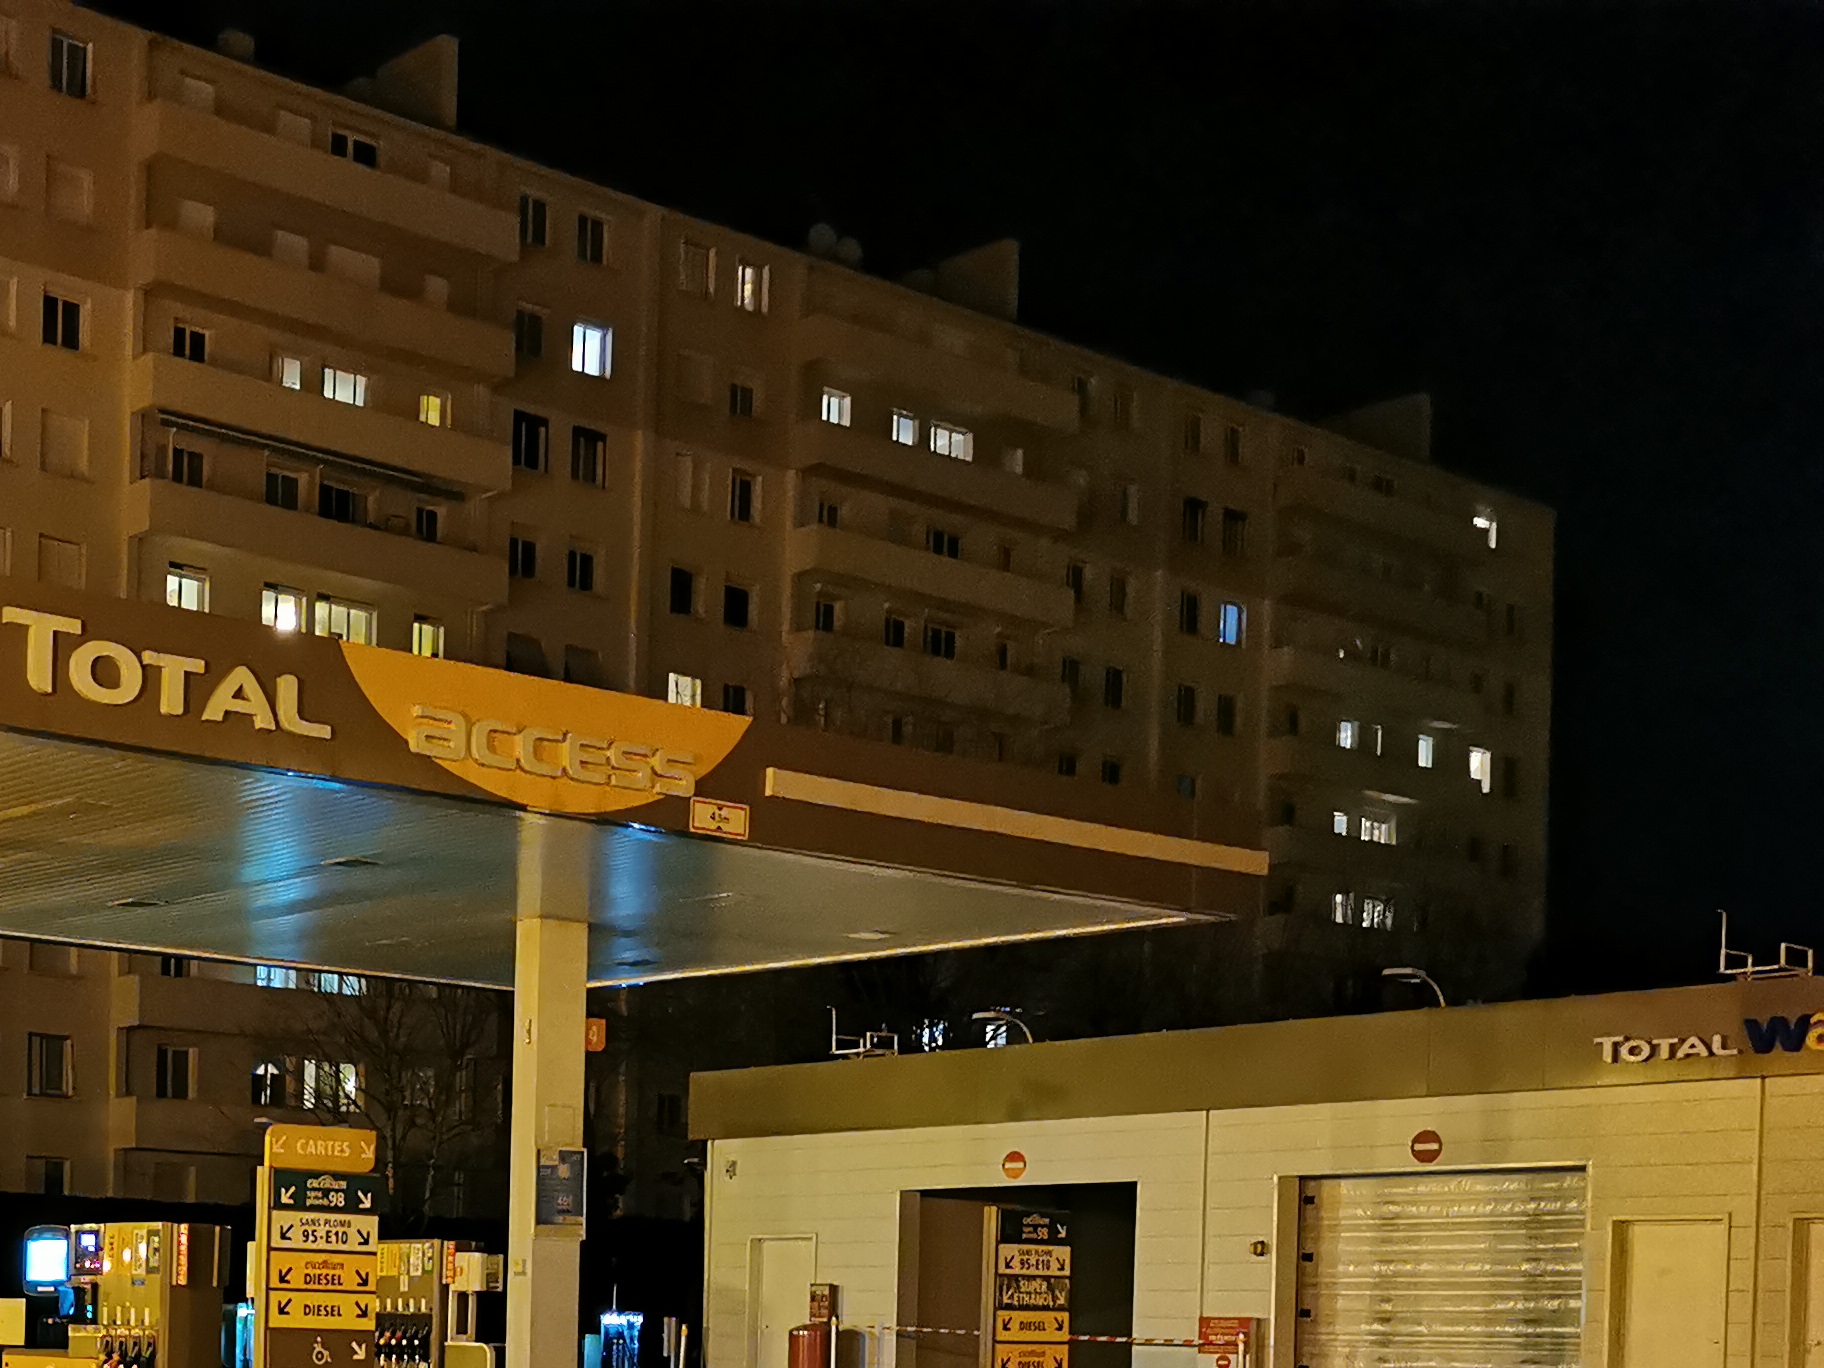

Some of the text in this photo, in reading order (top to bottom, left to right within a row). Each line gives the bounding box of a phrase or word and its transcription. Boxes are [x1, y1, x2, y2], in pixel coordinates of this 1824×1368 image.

[2, 606, 332, 739] TOTAL
[1593, 1033, 1739, 1064] TOTAL
[297, 1139, 351, 1157] CARTES
[329, 1191, 345, 1207] 98
[299, 1217, 352, 1228] SANS PLOMB
[303, 1273, 344, 1286] DIESEL
[303, 1304, 343, 1317] DIESEL
[1018, 1321, 1047, 1332] DIESEL
